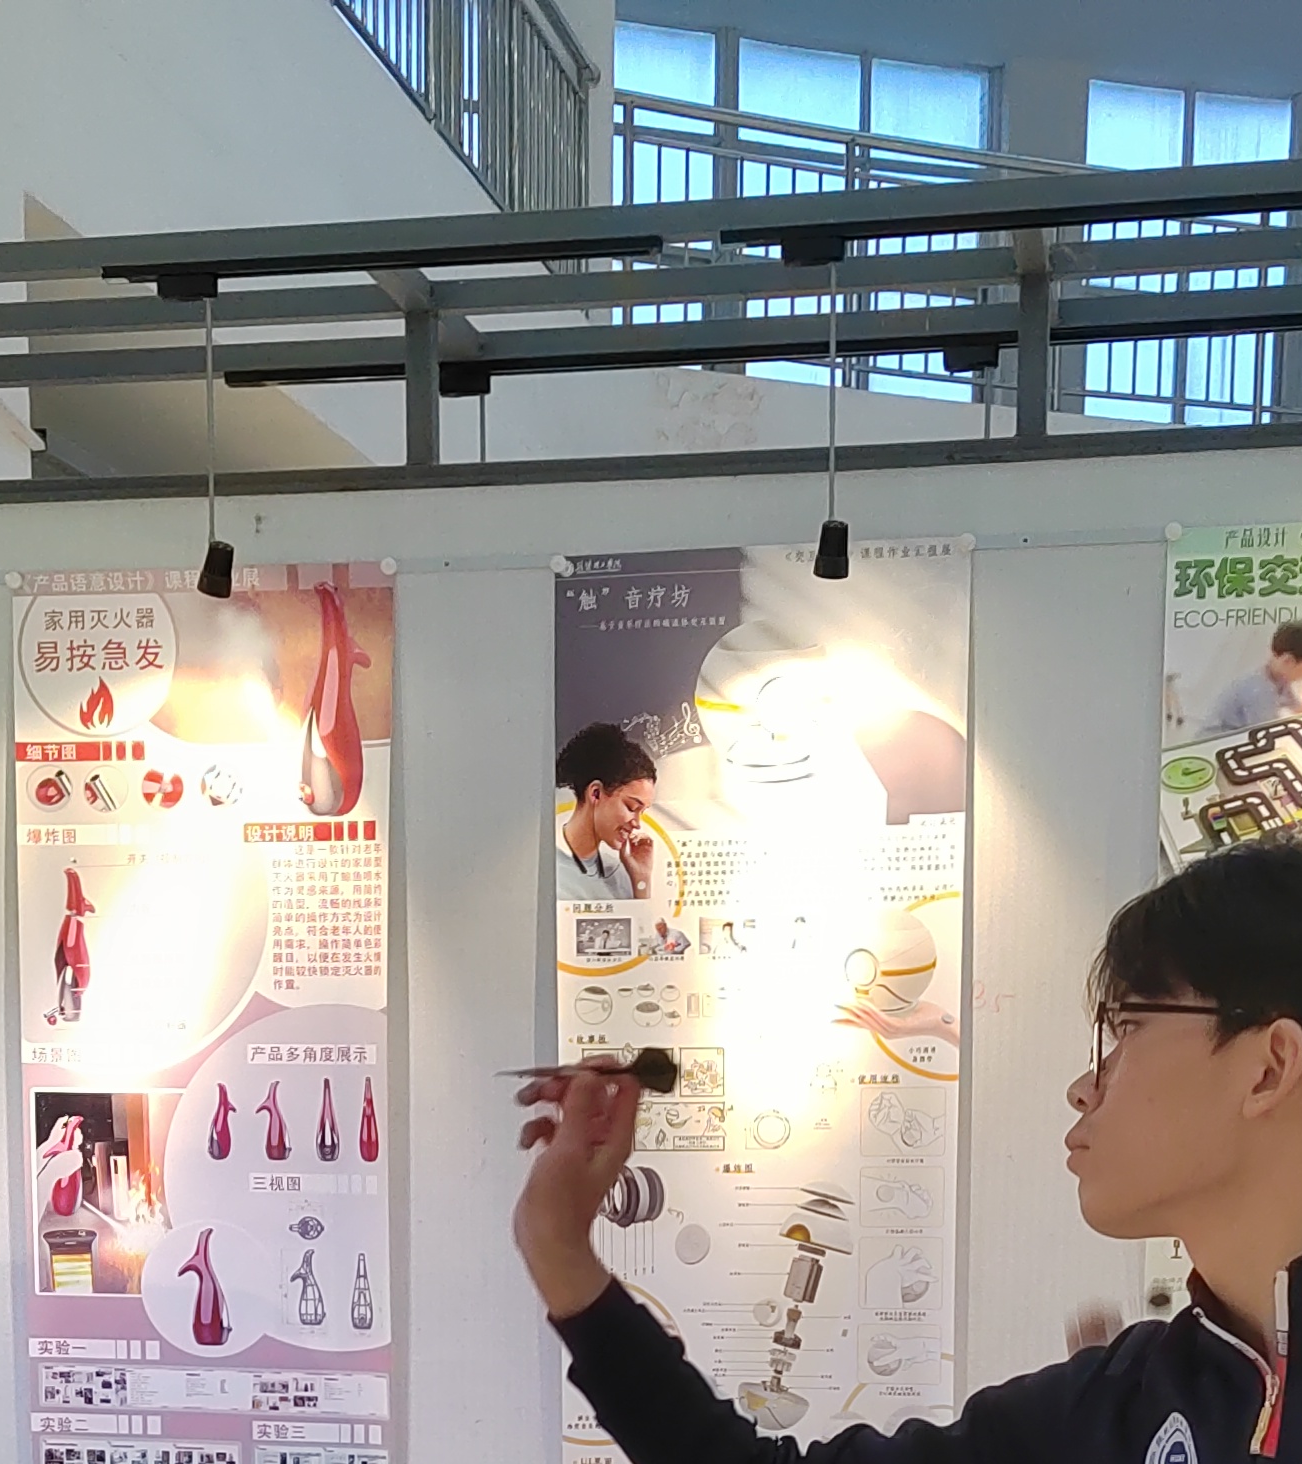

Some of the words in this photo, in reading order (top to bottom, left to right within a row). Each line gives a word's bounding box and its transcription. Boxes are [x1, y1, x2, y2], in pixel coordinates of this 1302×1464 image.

[43, 607, 156, 632] 家用灭火器
[32, 637, 164, 673] 易按急发
[25, 743, 78, 761] 细节图
[26, 827, 77, 845] 爆炸图
[245, 825, 314, 842] 设计说明
[249, 1045, 369, 1065] 产品多角度展示
[252, 1175, 302, 1194] 三视图
[36, 1339, 88, 1357] 实验一
[39, 1415, 90, 1433] 实验二
[256, 1423, 307, 1441] 实验三
